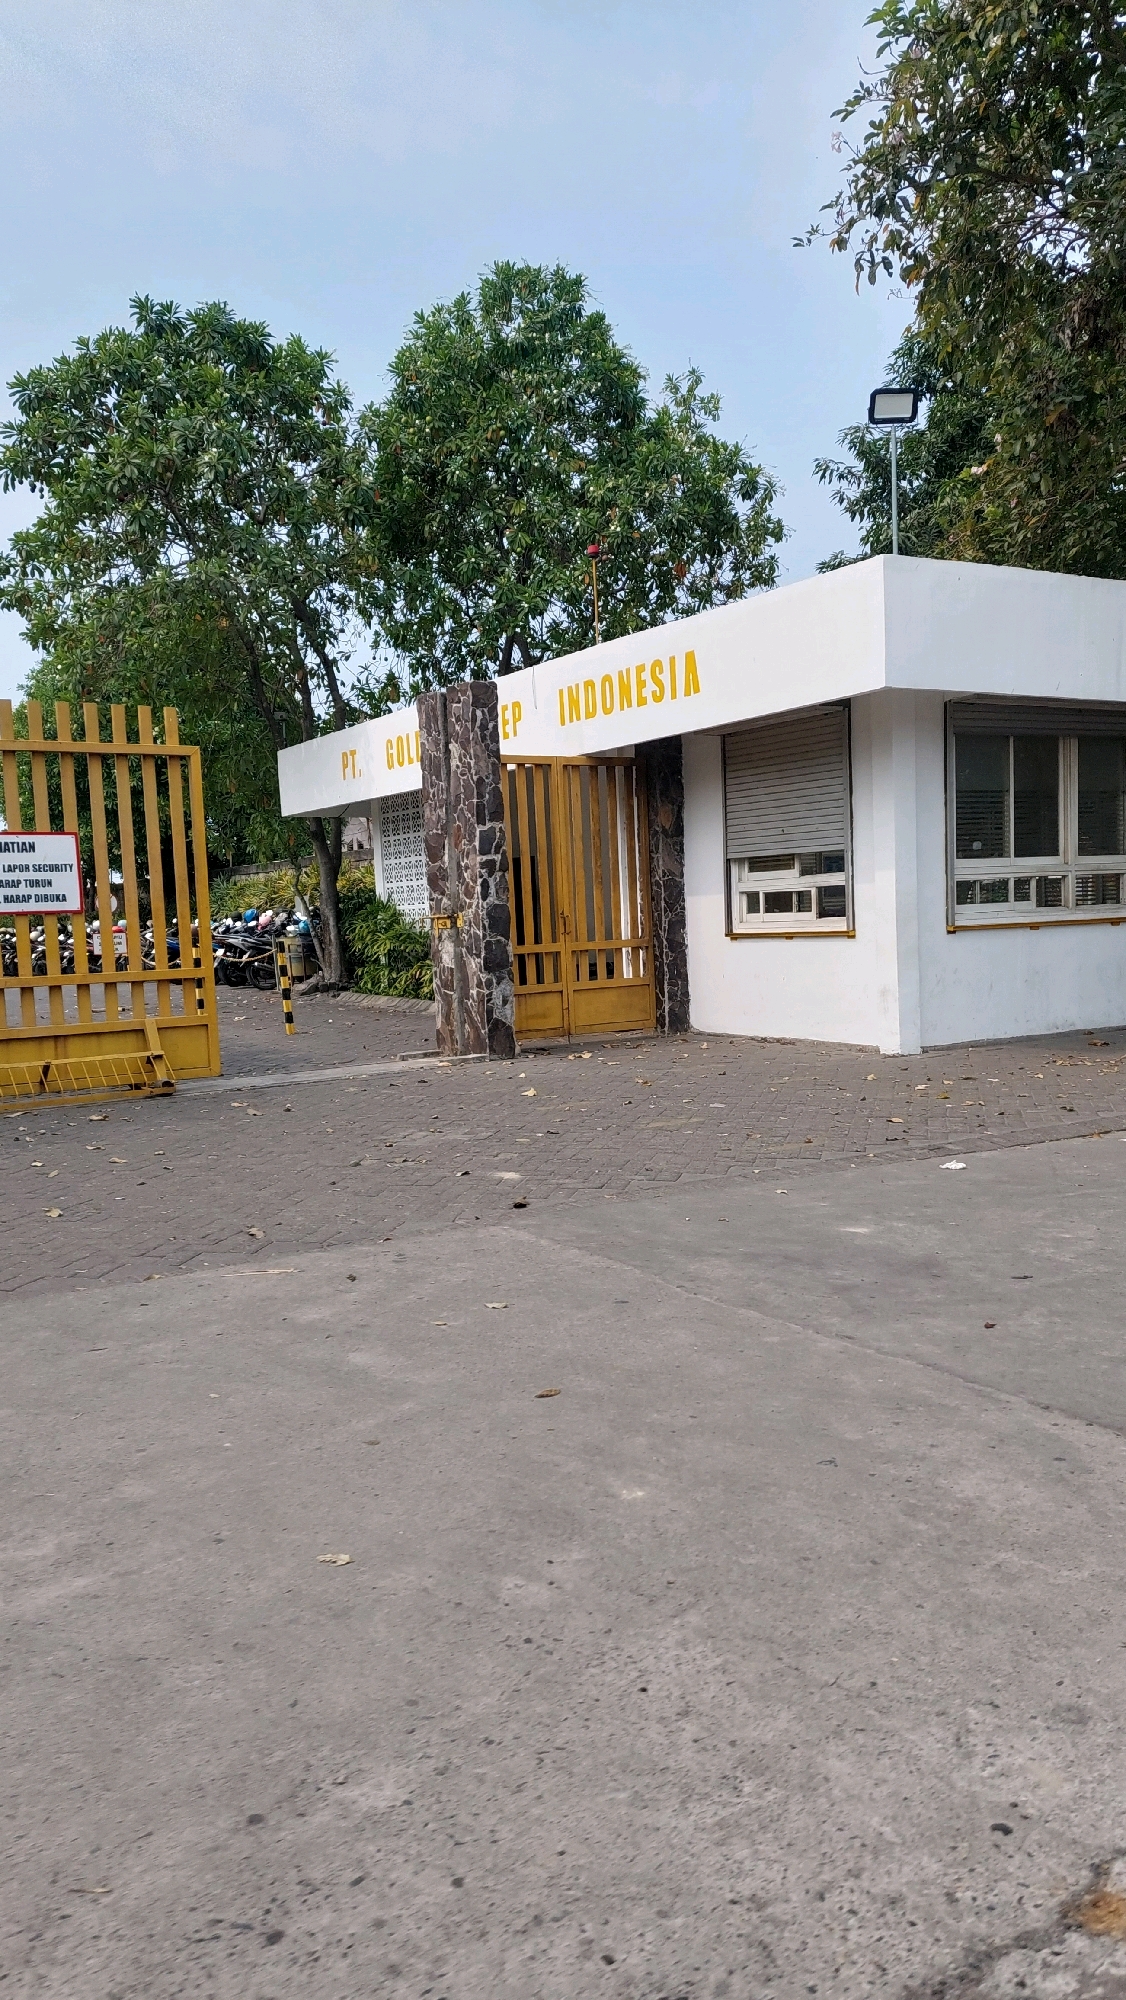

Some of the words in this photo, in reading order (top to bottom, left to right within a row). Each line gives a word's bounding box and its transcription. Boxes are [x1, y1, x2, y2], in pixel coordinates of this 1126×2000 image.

[341, 749, 362, 780] PT.
[501, 700, 523, 740] EP
[558, 650, 701, 727] INDONESIA
[3, 864, 30, 873] LAPOR
[32, 863, 74, 873] SECURITY
[23, 879, 53, 888] TURUN
[3, 894, 33, 904] HARAP
[34, 893, 68, 903] DIBUKA
